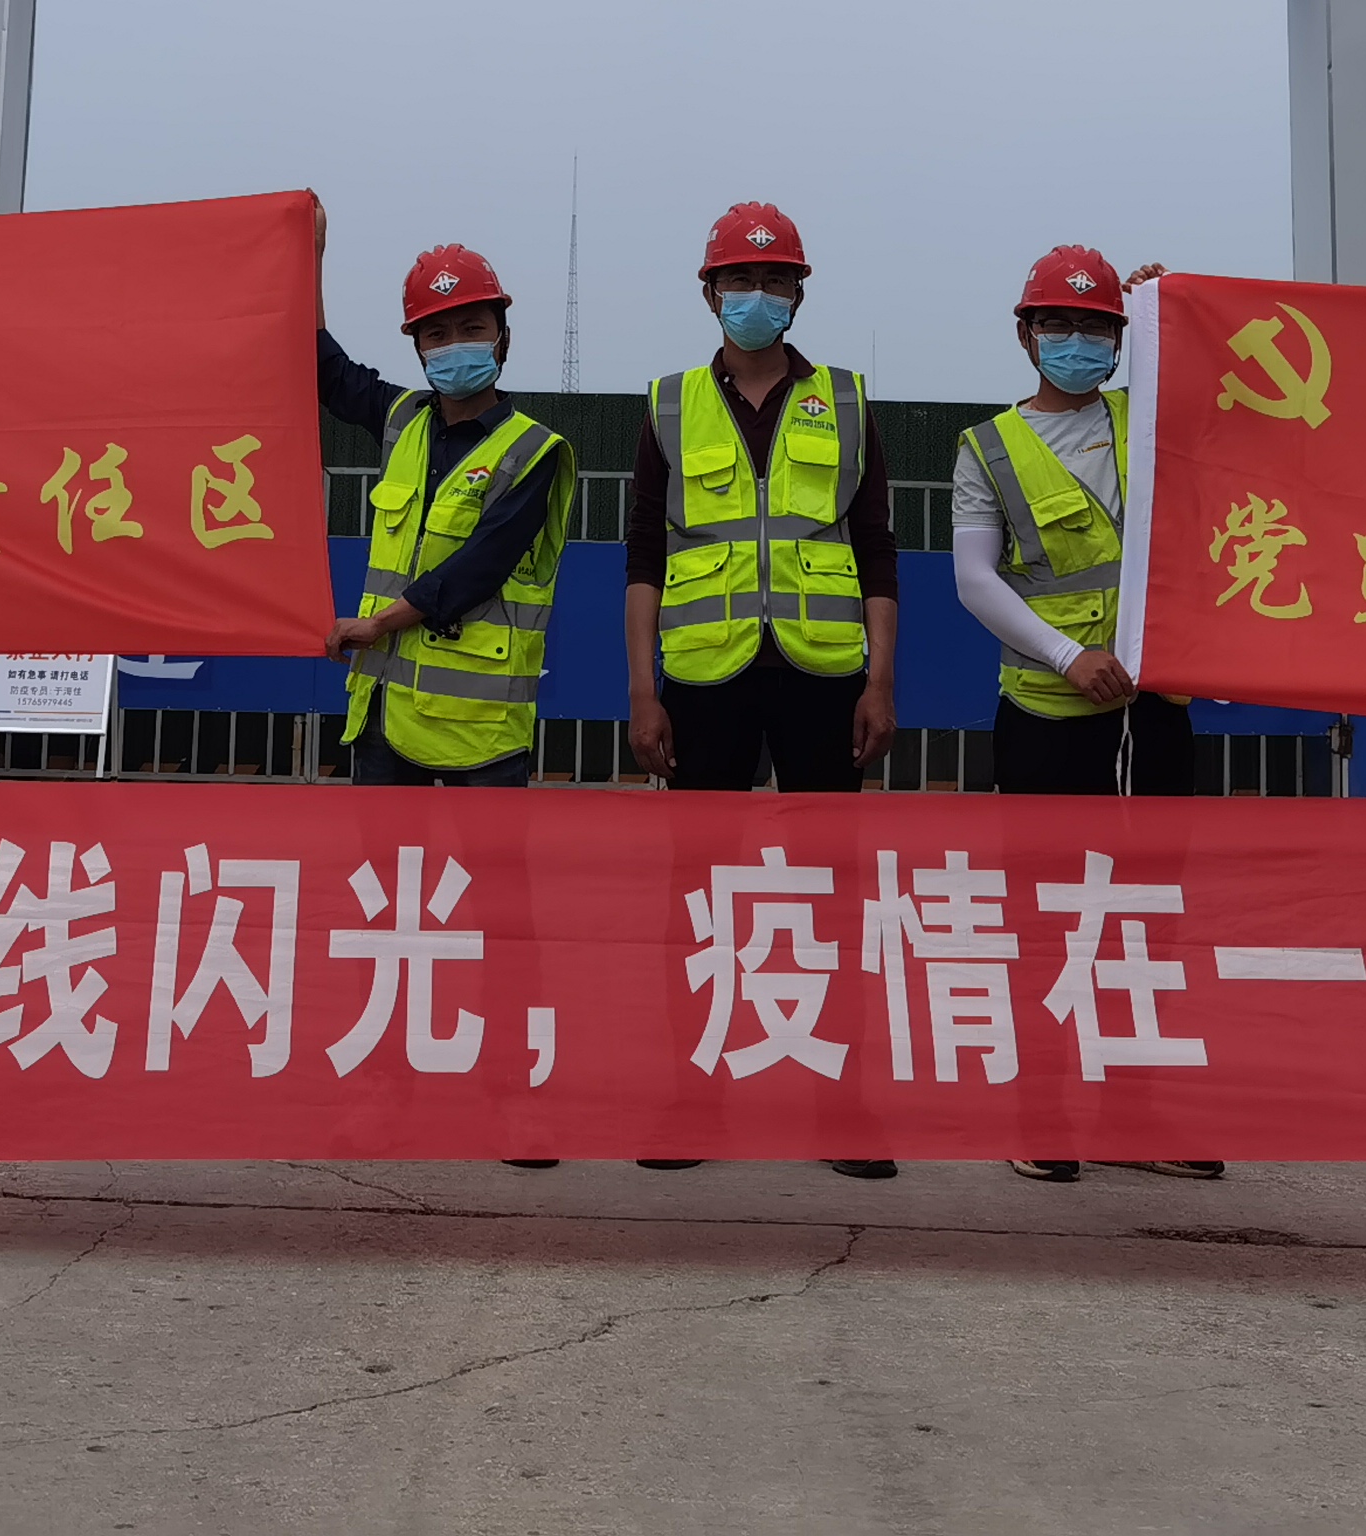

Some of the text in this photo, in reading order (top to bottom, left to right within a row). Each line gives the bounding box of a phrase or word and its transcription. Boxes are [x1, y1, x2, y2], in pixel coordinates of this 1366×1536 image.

[8, 669, 89, 681] 如有急事 请打电话
